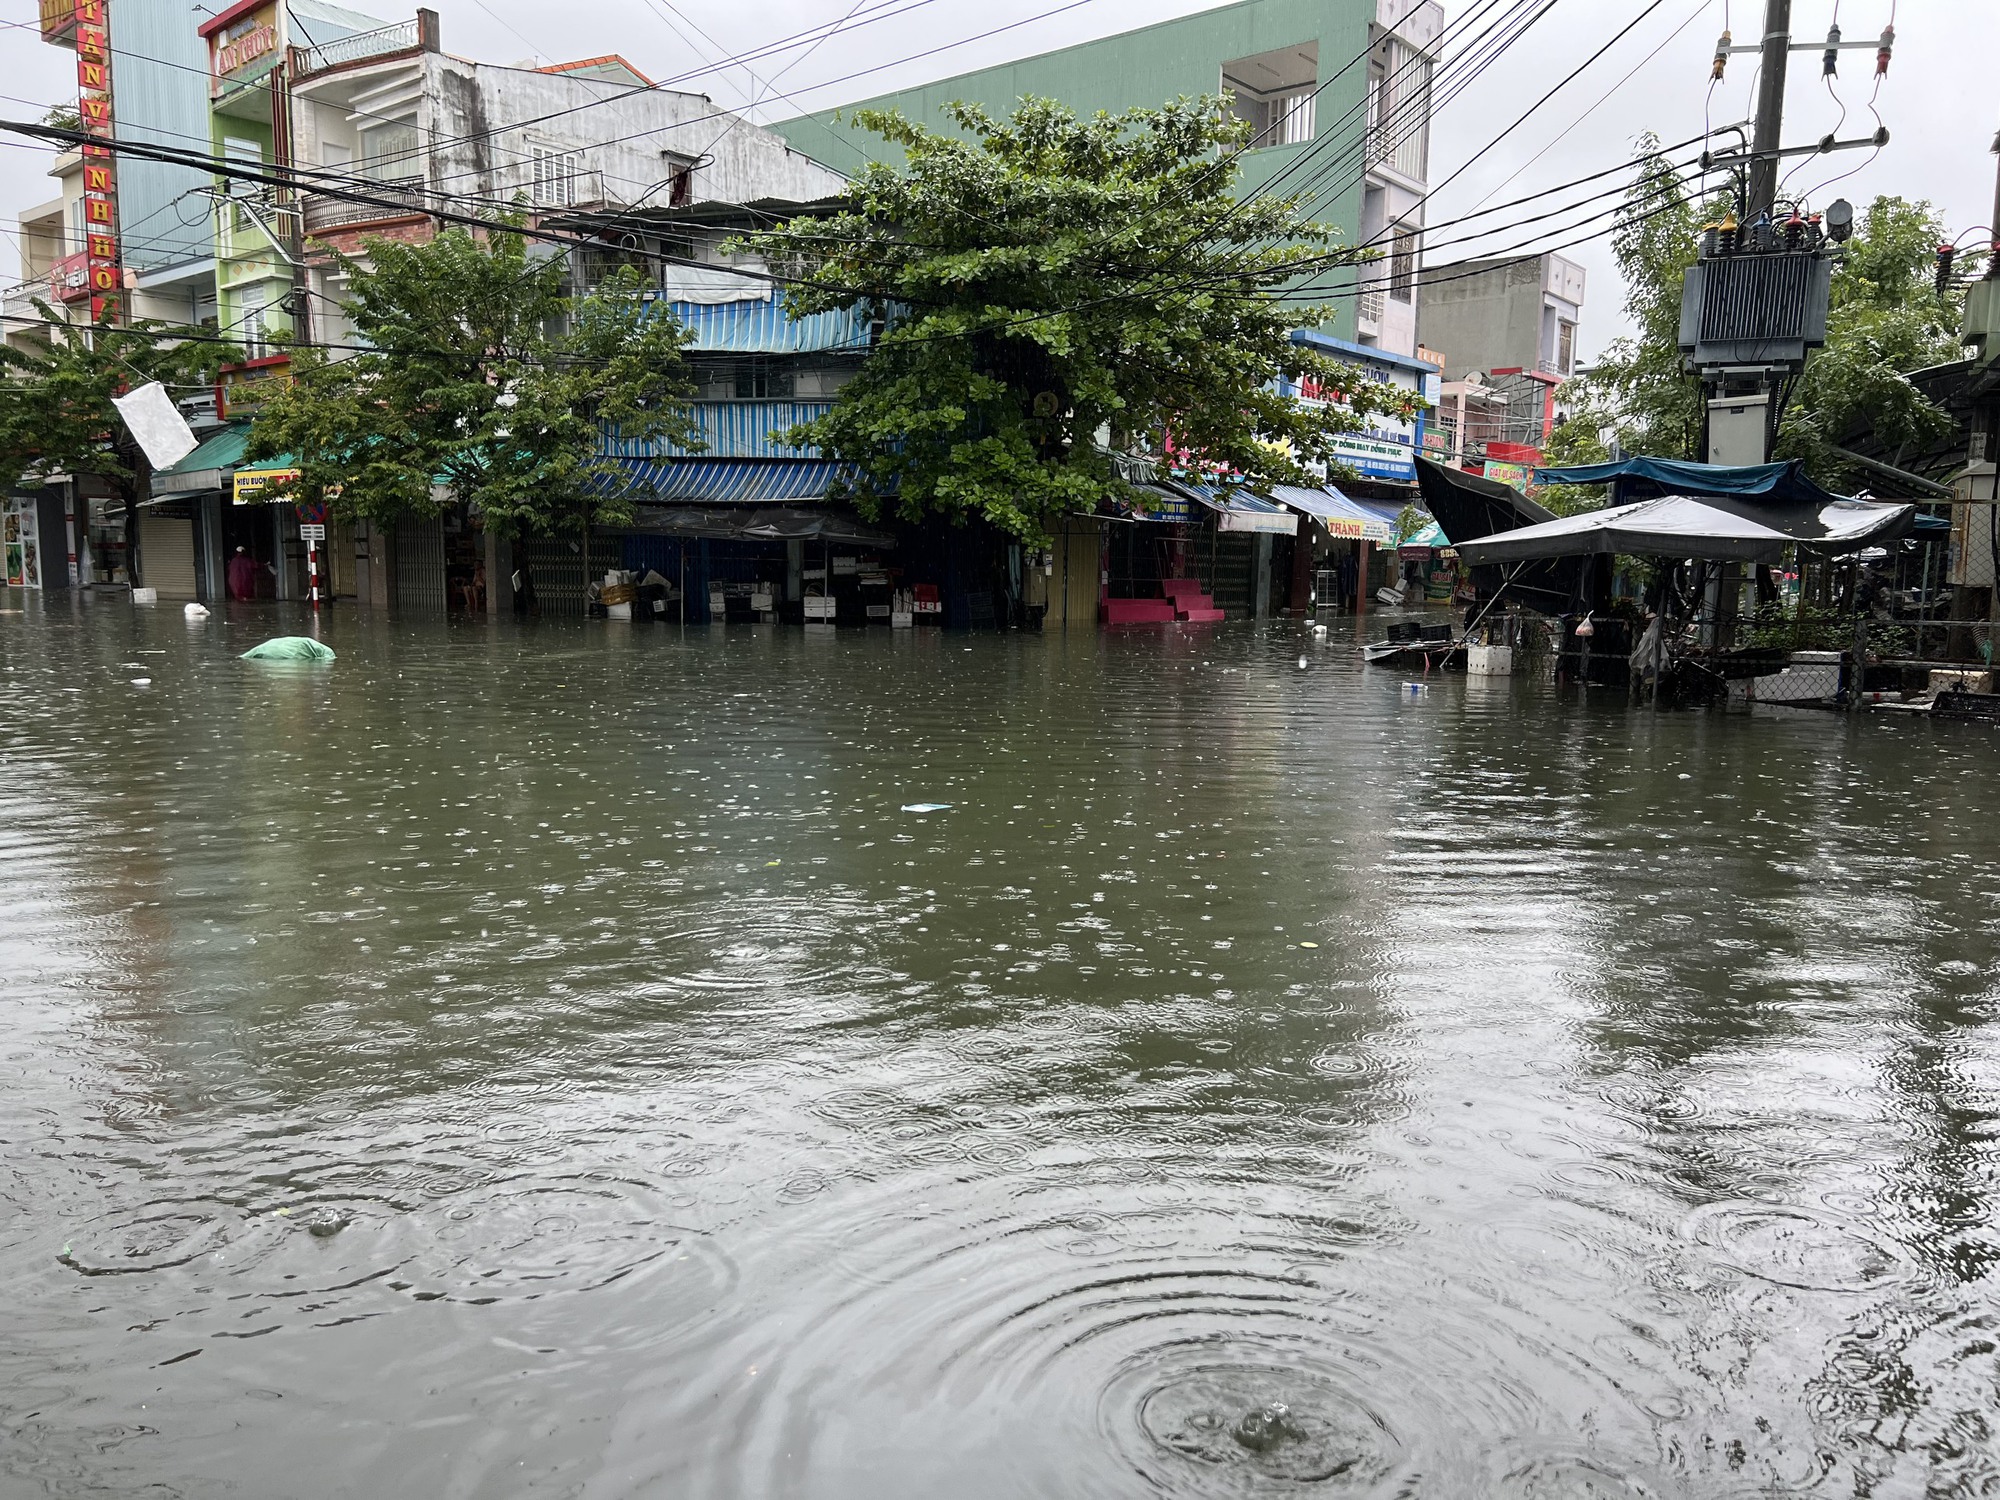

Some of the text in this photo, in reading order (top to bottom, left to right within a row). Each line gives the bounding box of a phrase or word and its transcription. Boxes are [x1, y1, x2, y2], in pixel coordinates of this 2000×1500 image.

[81, 0, 101, 86] TÂN
[219, 45, 237, 76] AN
[86, 102, 109, 221] VNH
[1329, 520, 1360, 536] THÀNH
